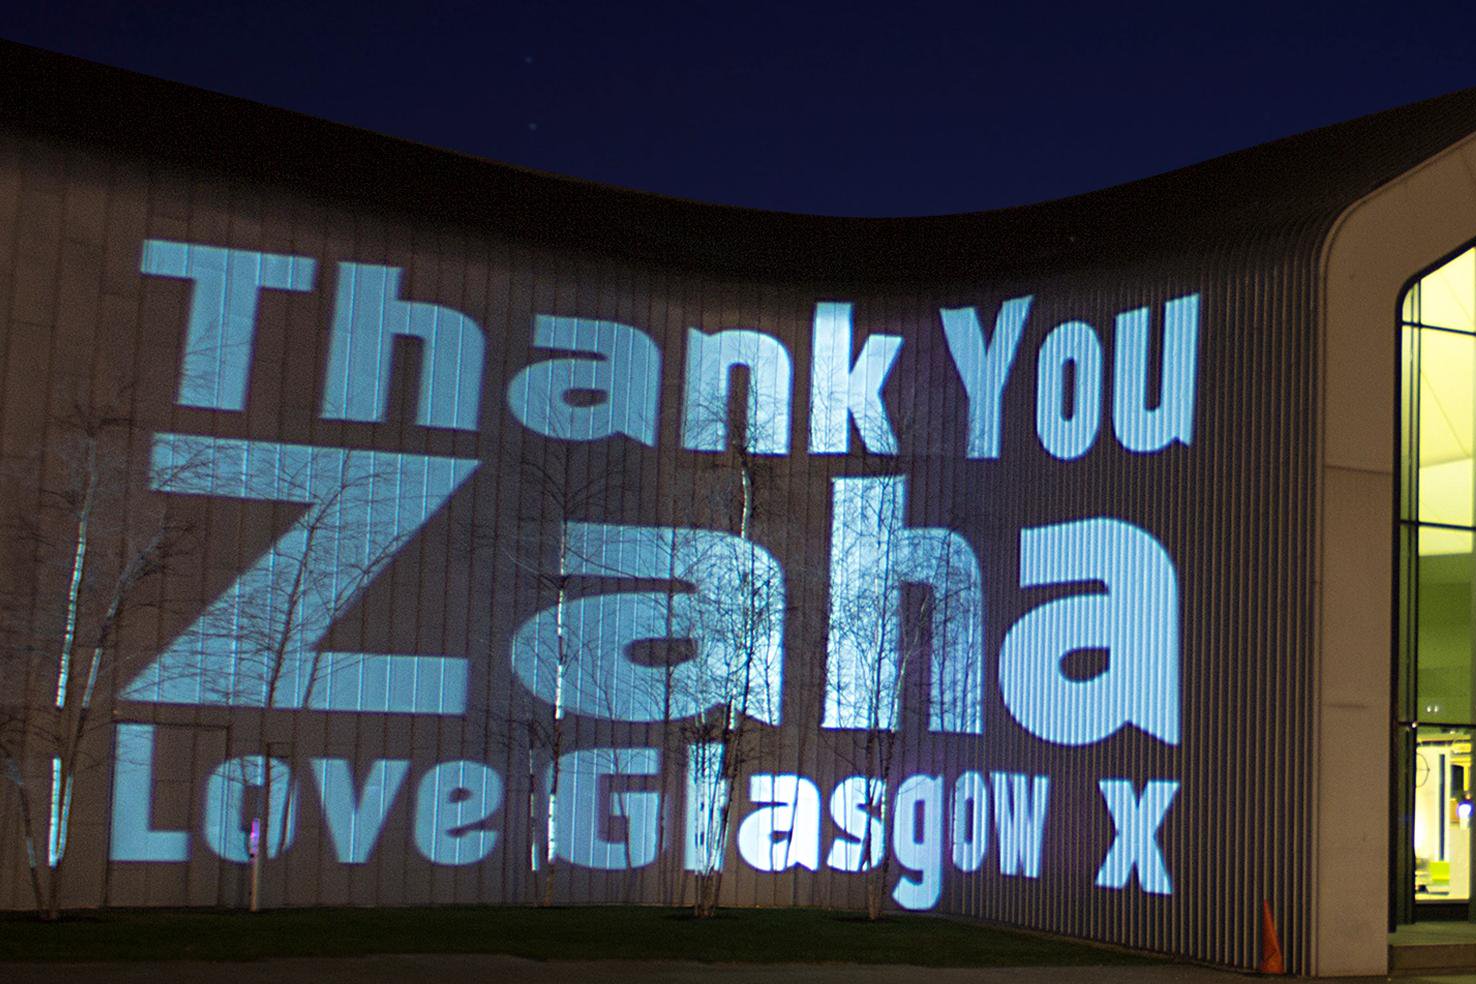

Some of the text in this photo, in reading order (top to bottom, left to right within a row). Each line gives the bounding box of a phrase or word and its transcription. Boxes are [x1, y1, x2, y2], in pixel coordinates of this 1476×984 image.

[140, 238, 1201, 460] Thank You
[120, 432, 1181, 748] Zaha
[110, 722, 504, 866] Love
[543, 742, 1051, 911] Glasgow
